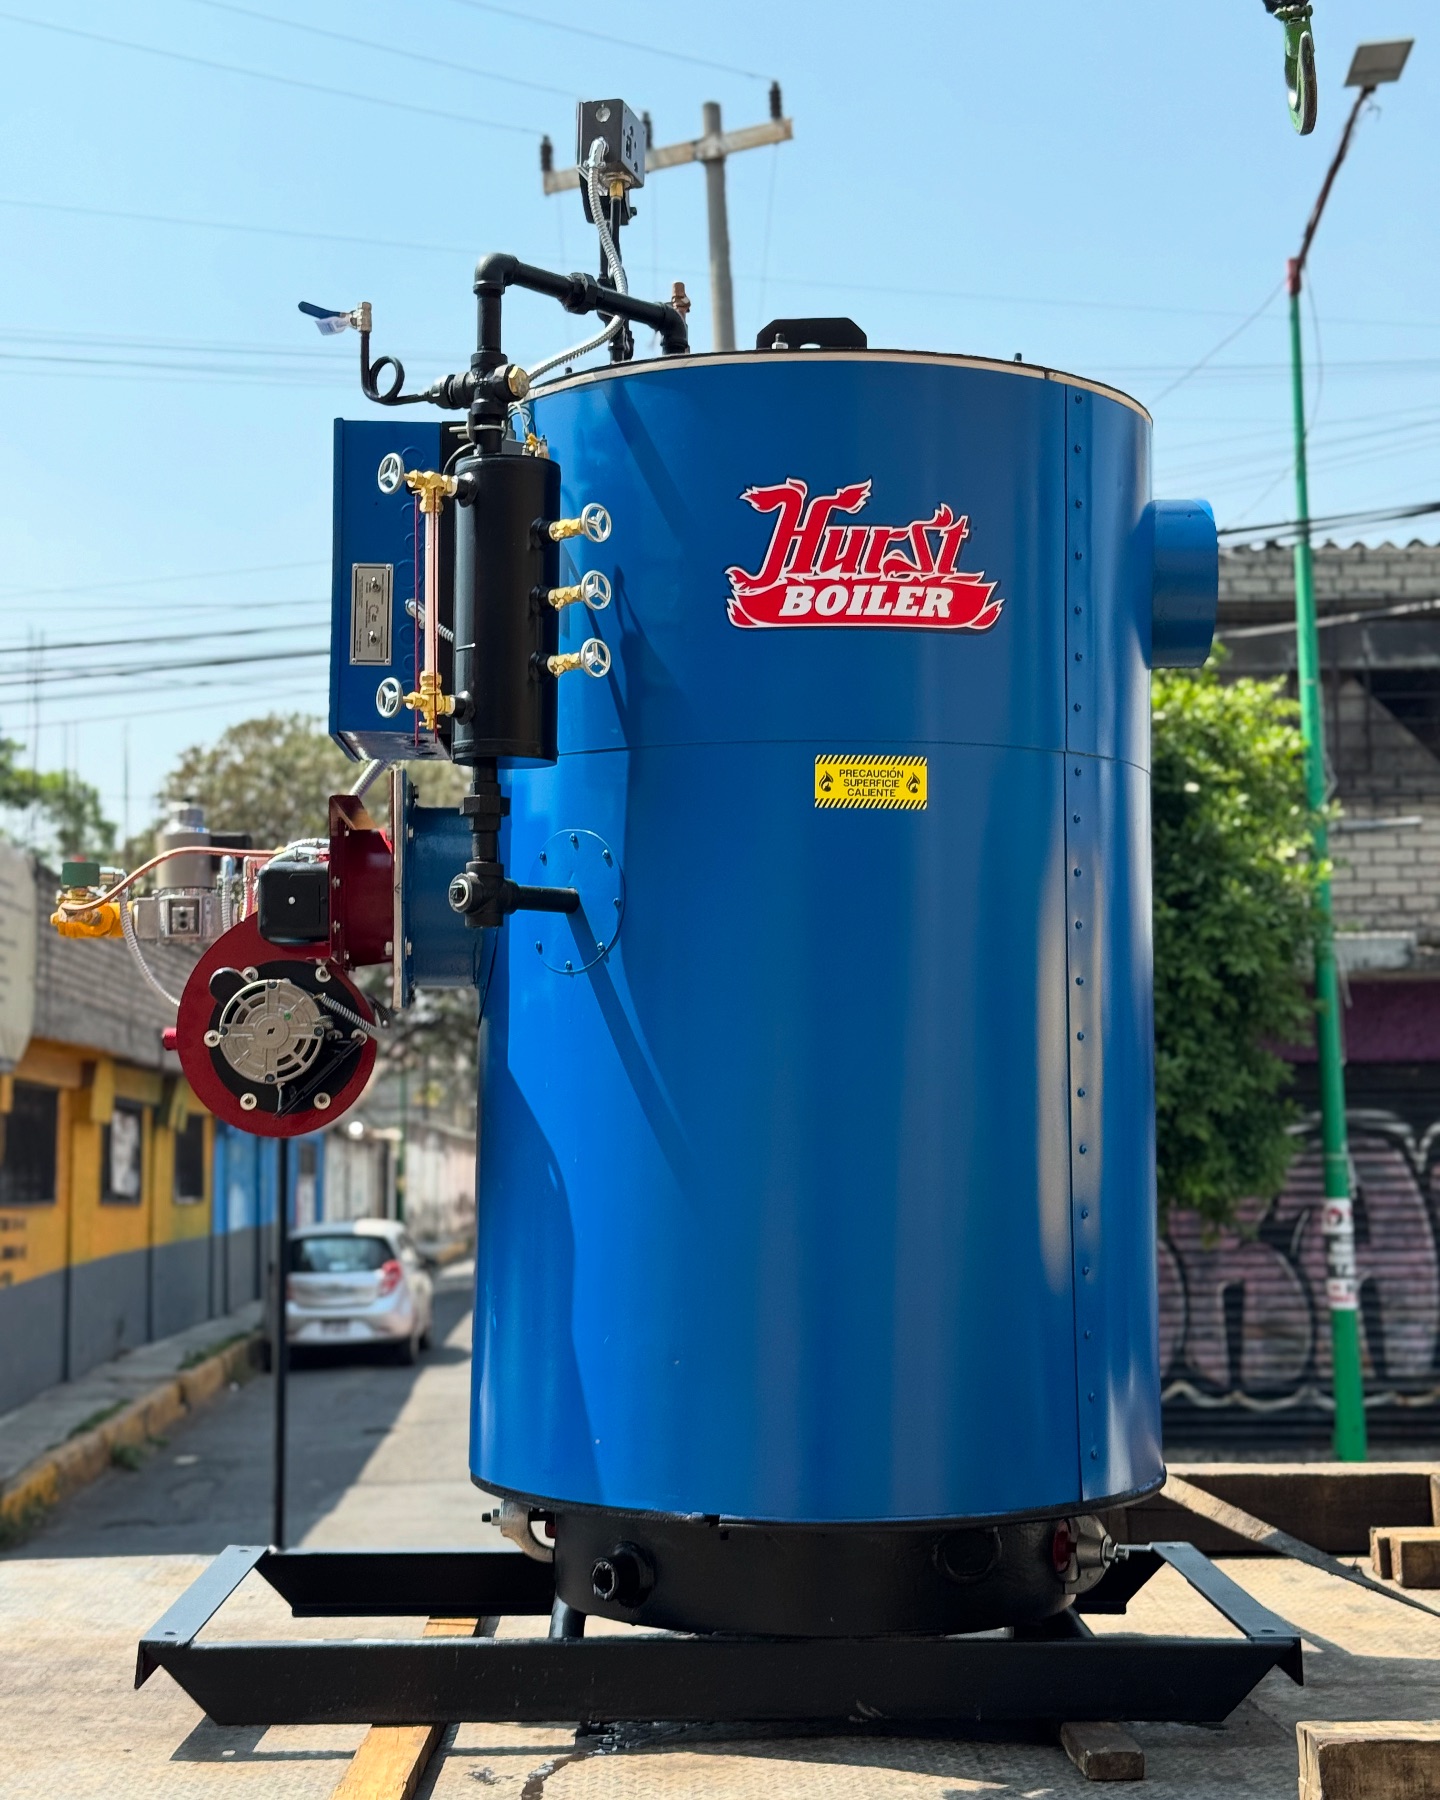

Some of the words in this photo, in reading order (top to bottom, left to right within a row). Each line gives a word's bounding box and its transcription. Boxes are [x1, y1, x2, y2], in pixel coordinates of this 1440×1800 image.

[725, 477, 970, 592] Hurst
[778, 584, 954, 618] BOILER
[839, 767, 904, 778] PRECAUCIÓN
[843, 779, 900, 788] SUPERFICIE
[847, 788, 896, 797] CALIENTE
